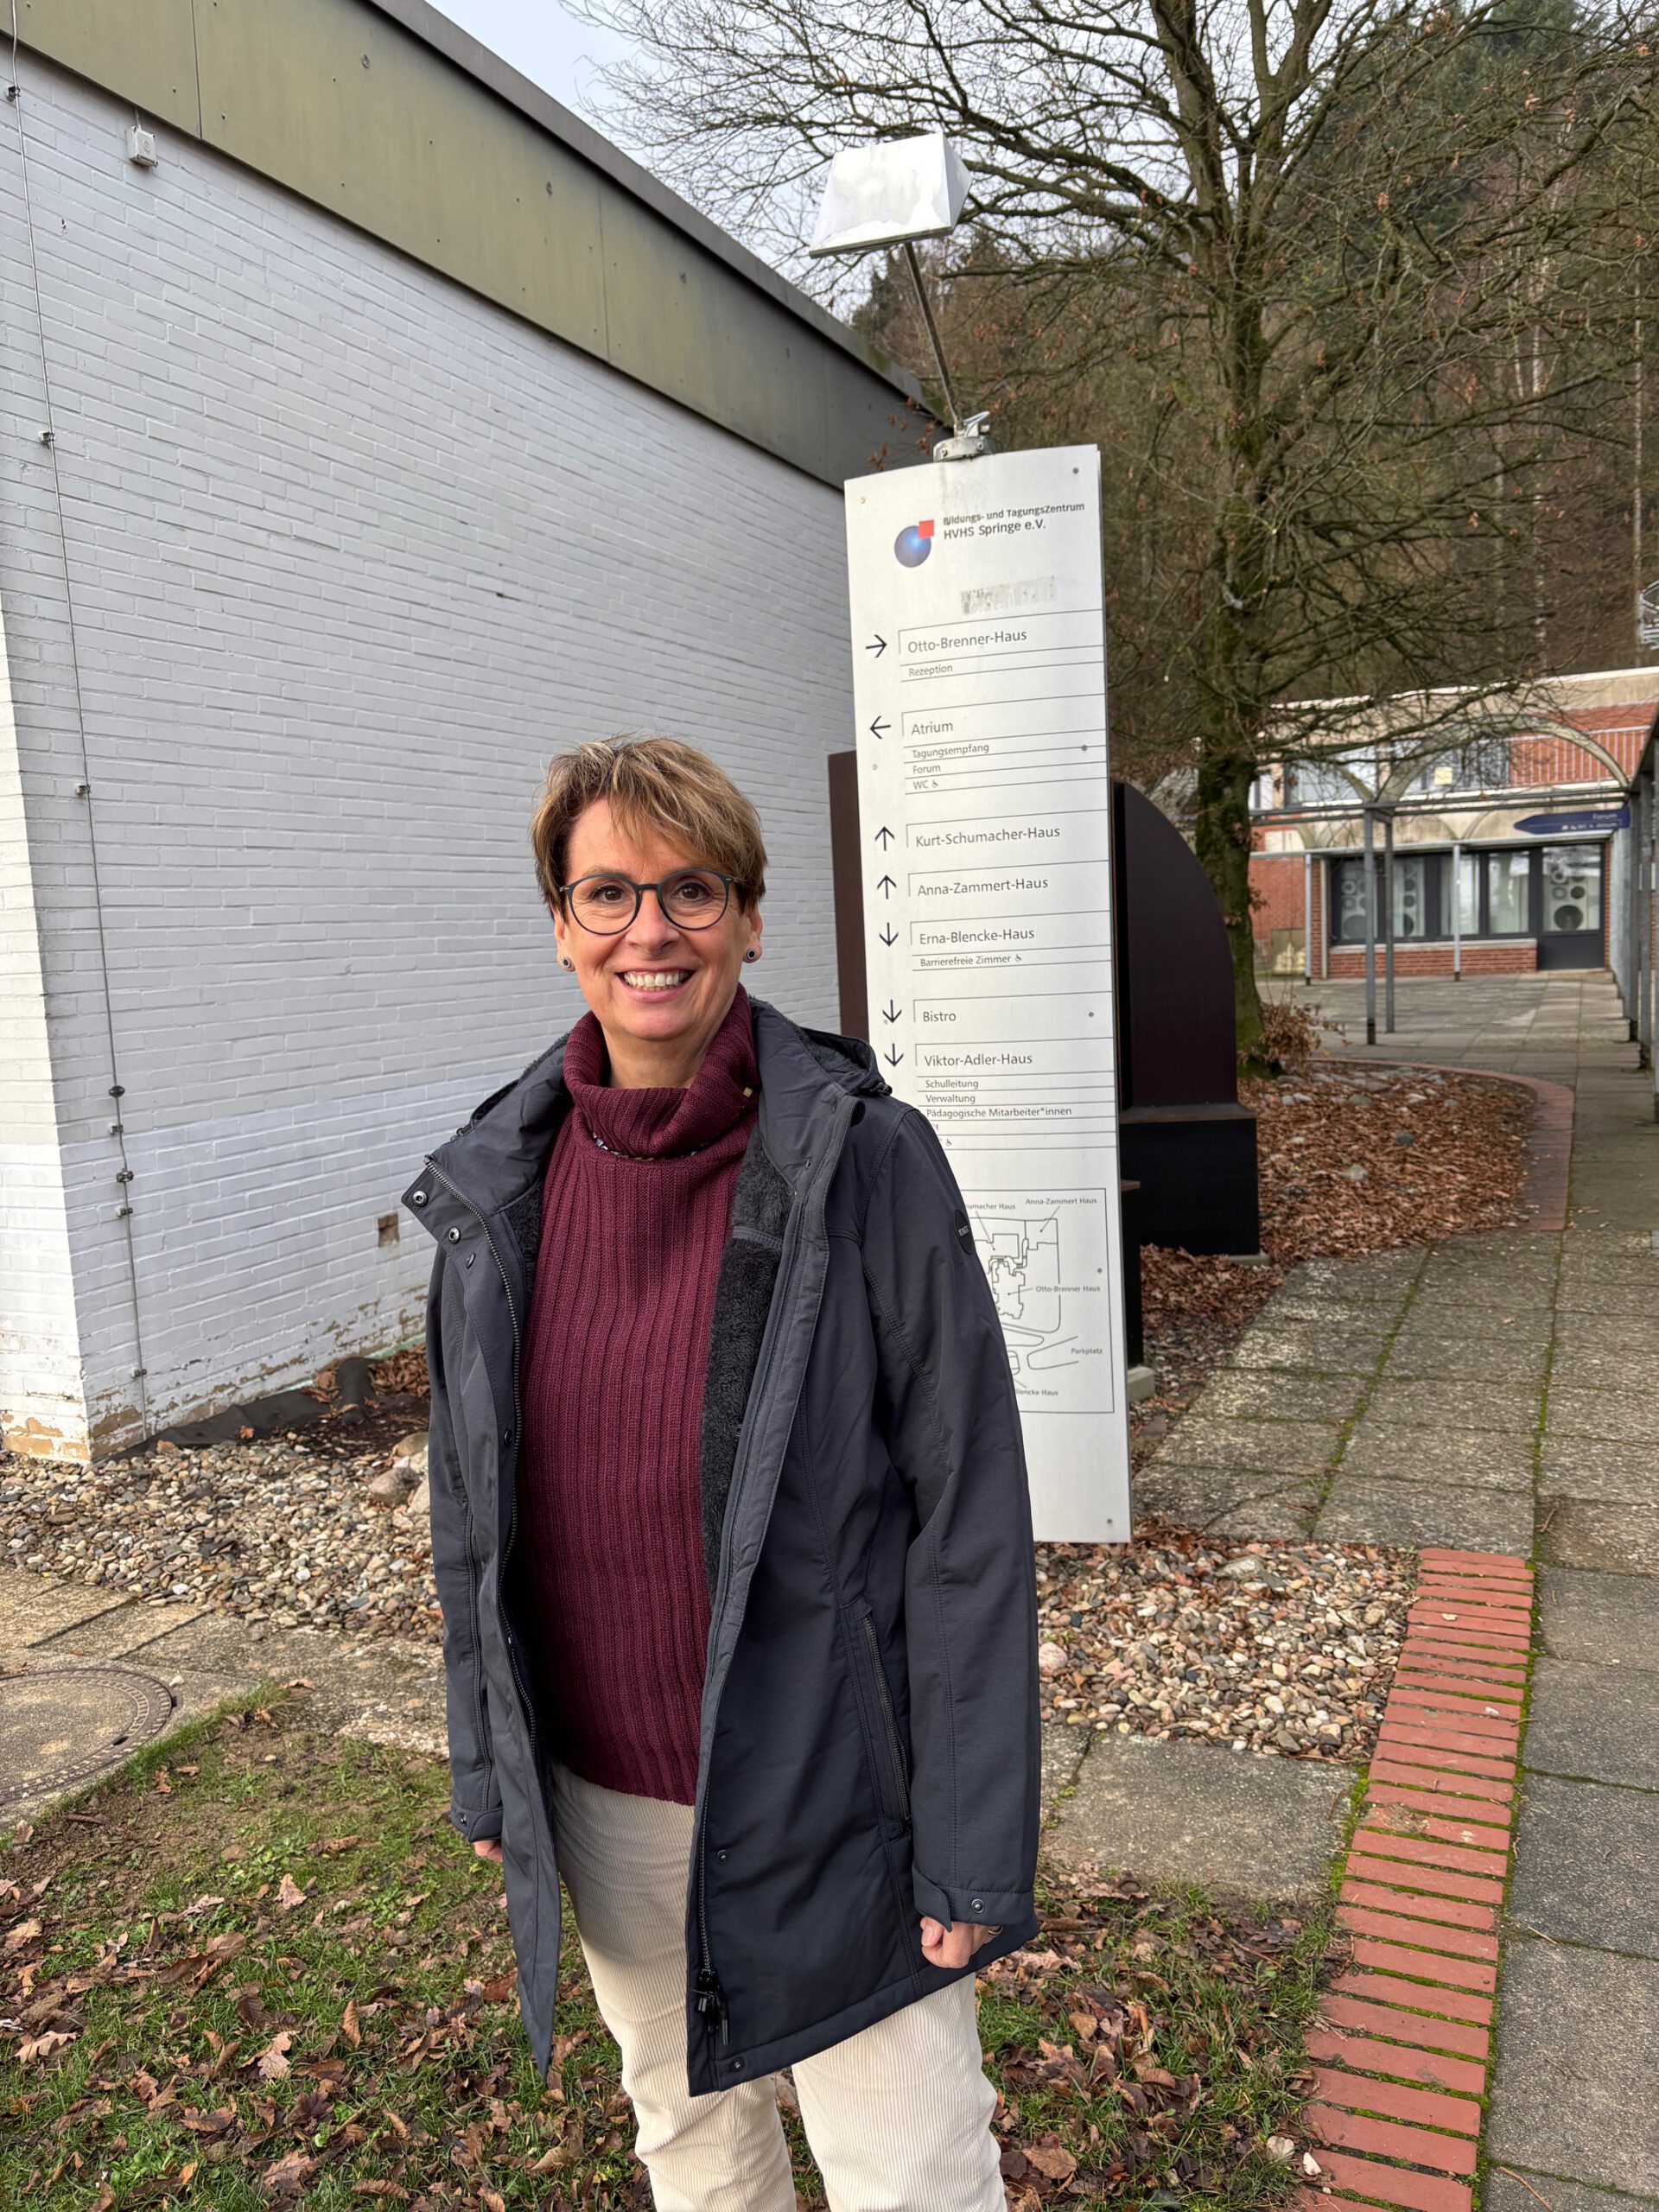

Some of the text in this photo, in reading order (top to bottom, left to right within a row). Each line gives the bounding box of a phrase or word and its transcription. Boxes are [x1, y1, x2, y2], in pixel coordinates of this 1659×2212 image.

[943, 503, 1085, 525] Bildungs- und TagungsZentrum
[944, 518, 1046, 540] HVHS Springe e.V.
[907, 631, 1027, 653] Otto-Brenner-Haus
[909, 664, 954, 677] Rezeption
[911, 721, 954, 736] Atrium
[912, 743, 989, 760] Tagungsempfang
[912, 765, 941, 775] Forum
[912, 779, 930, 791] WC
[915, 826, 1061, 848] Kurt-Schumacher-Haus
[917, 878, 1049, 897] Anna-Zammert-Haus
[919, 927, 1035, 945] Erna-Blencke-Haus
[919, 954, 1011, 968] Barrierefreie Zimmer
[923, 1010, 957, 1022] Bistro
[924, 1052, 1033, 1067] Viktor-Adler-Haus
[925, 1079, 979, 1090] Schulleitung
[925, 1094, 976, 1104] Verwaltung
[926, 1108, 987, 1119] Pädagogische
[1035, 1285, 1081, 1294] Otto-Brenner
[1071, 1347, 1103, 1356] Parkplatz
